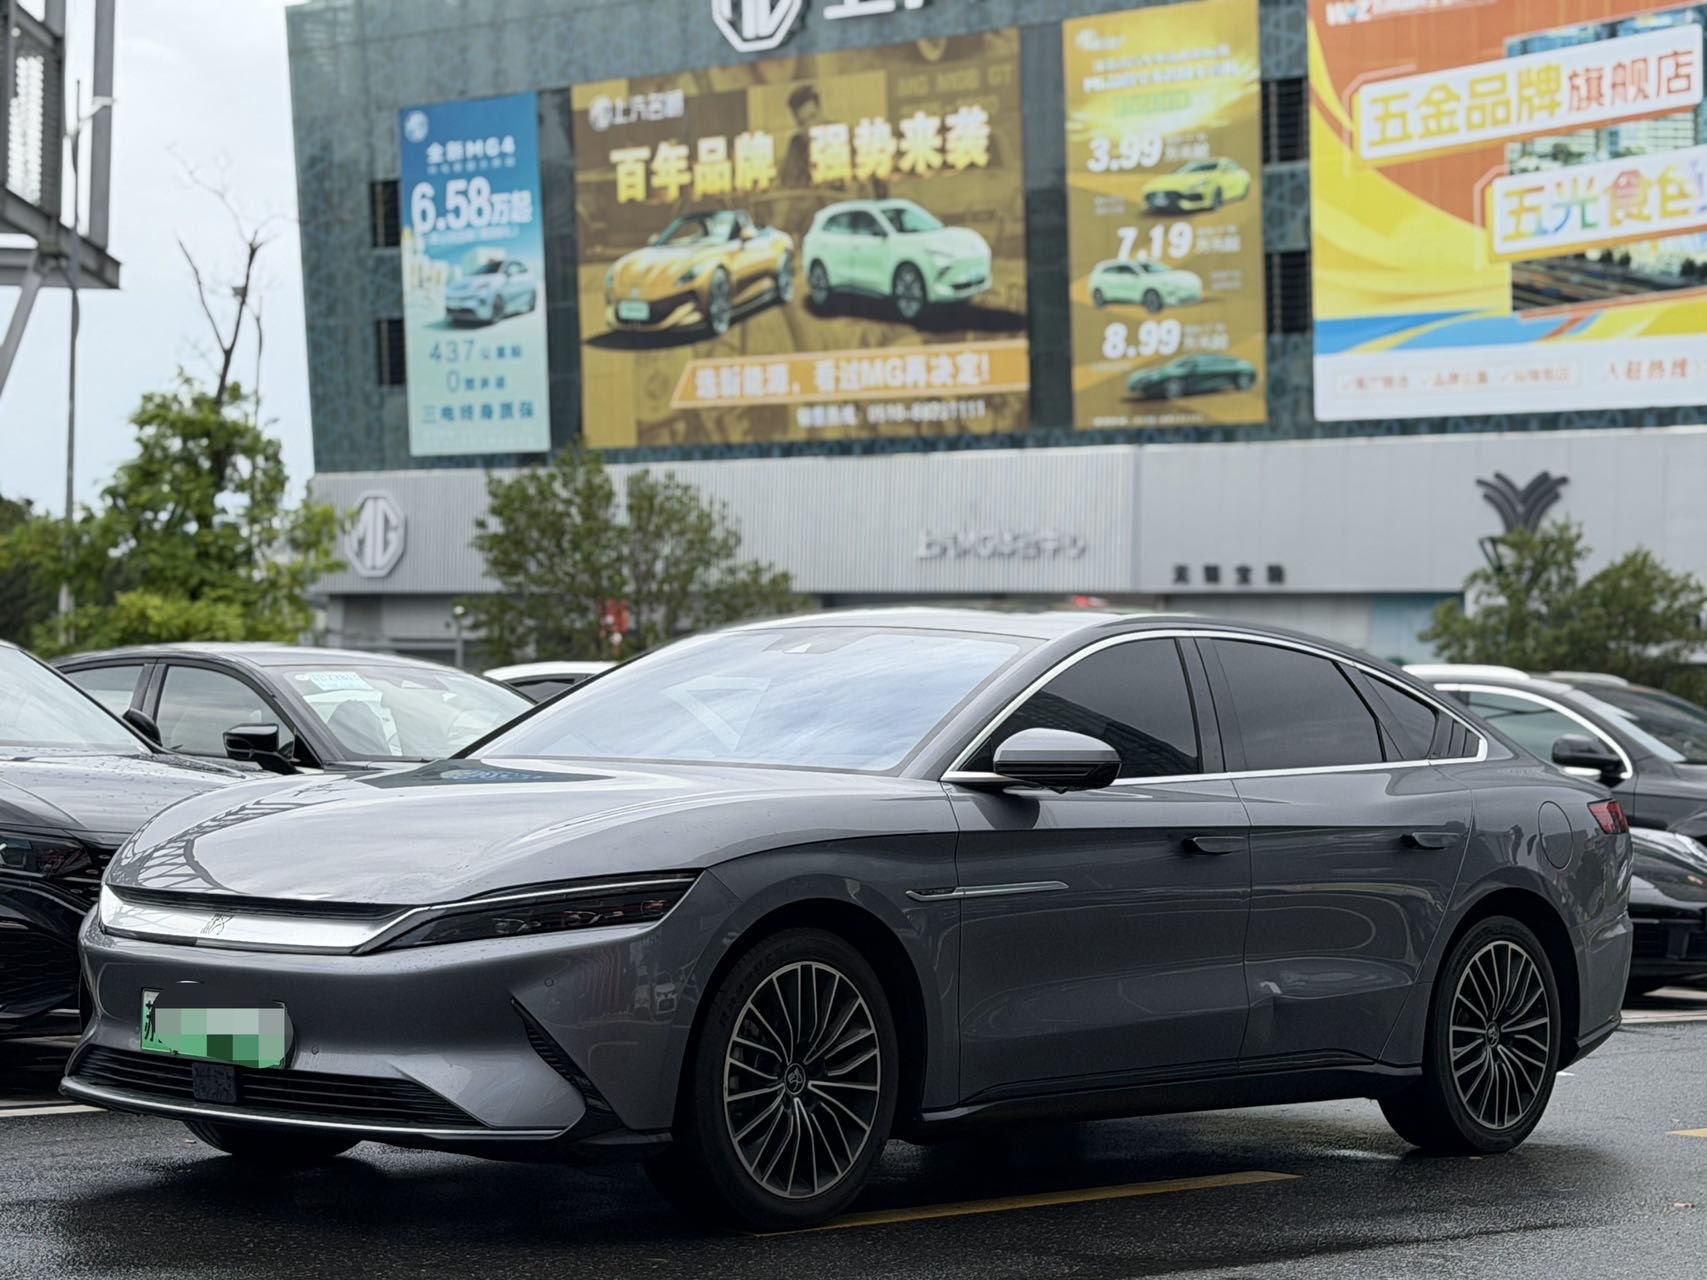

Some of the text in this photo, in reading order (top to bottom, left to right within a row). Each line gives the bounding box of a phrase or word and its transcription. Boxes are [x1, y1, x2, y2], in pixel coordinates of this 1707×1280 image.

[1368, 50, 1694, 148] 五金品牌旗舰店
[610, 105, 990, 204] 百年品牌 强势来袭
[1087, 131, 1164, 173] 3.99
[1117, 222, 1193, 261] 7.19
[1102, 319, 1181, 359] 8.99
